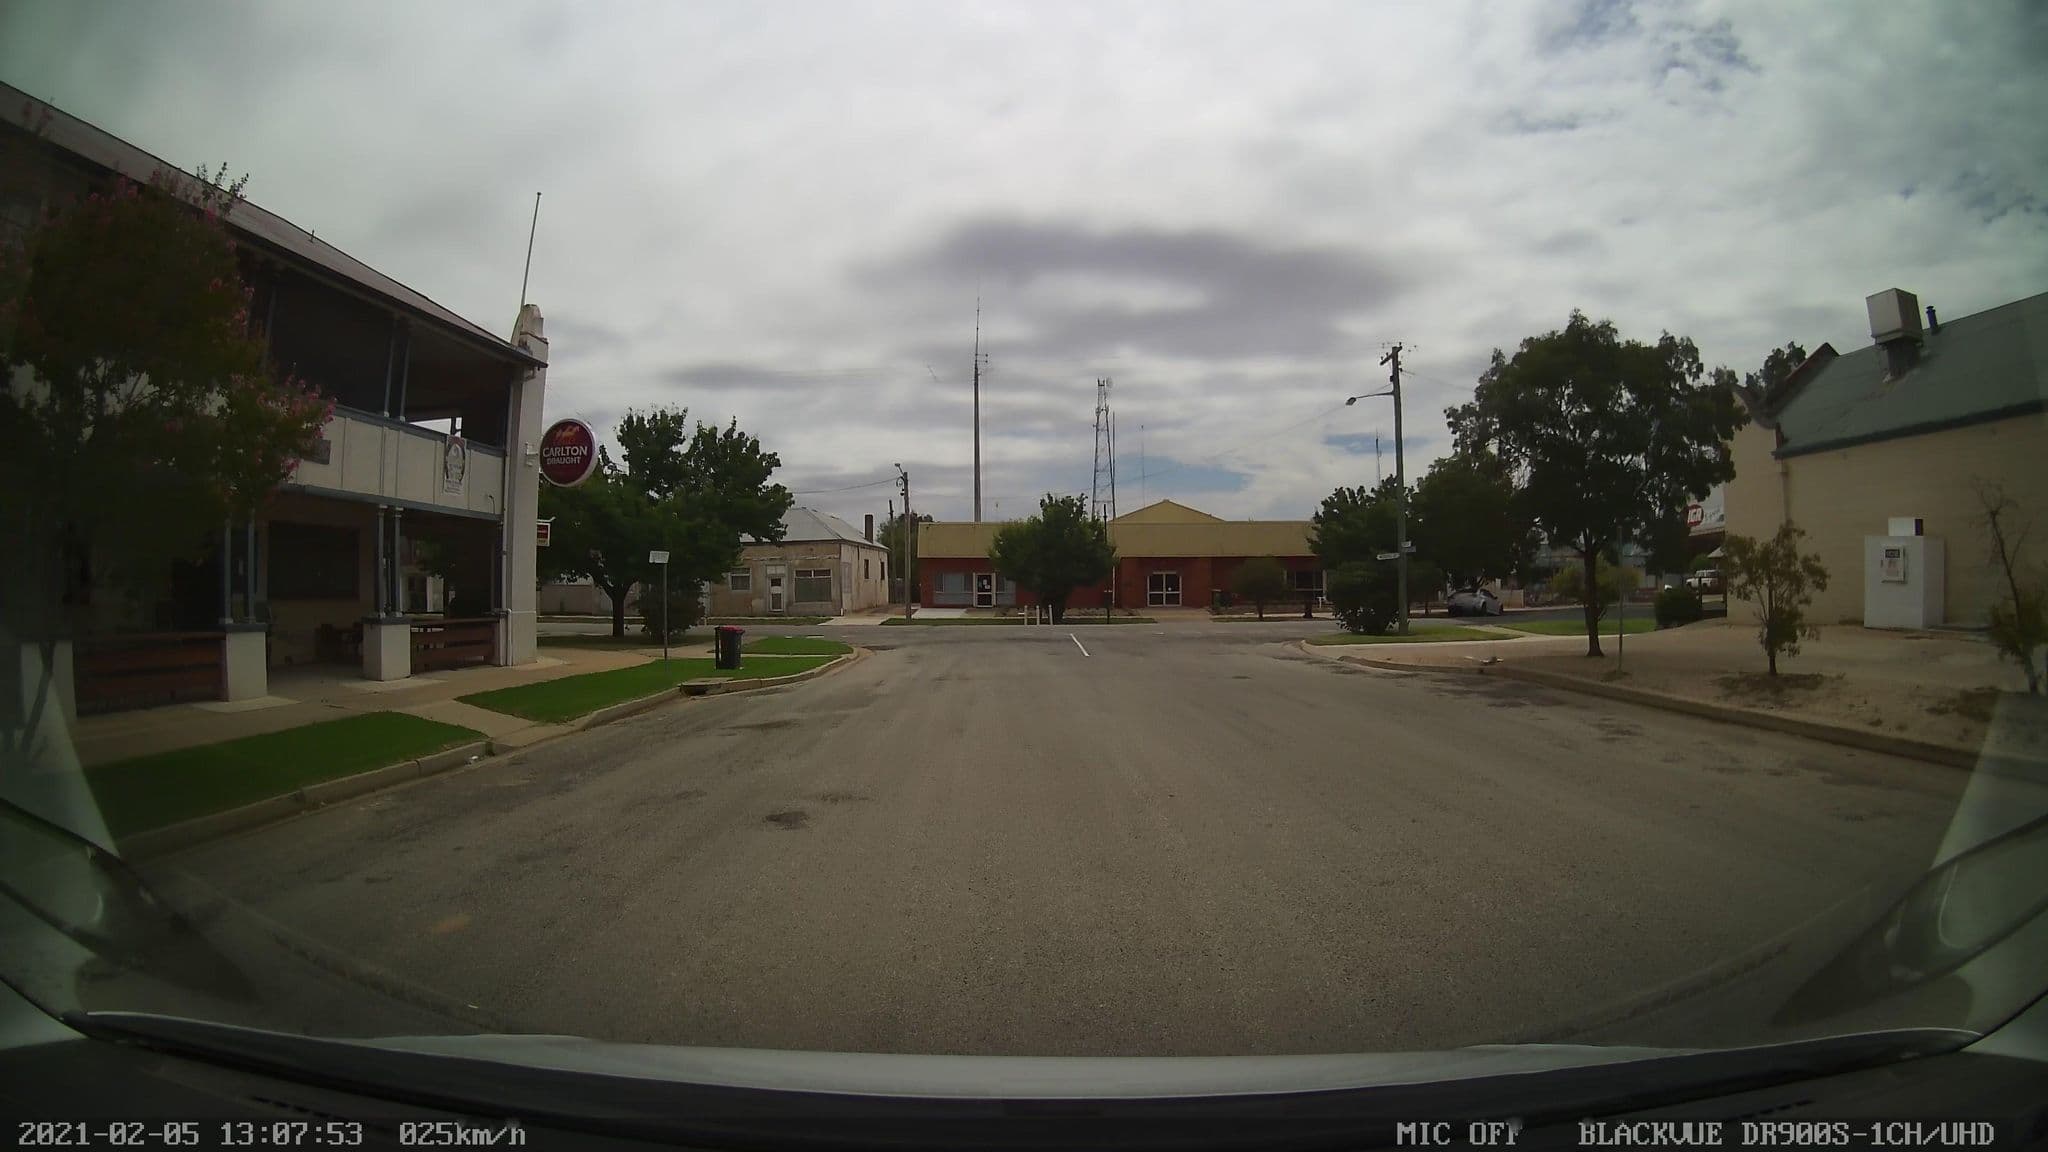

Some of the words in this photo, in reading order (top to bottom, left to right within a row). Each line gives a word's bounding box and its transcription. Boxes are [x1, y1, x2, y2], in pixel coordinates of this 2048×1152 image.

[542, 446, 588, 457] CARLTON
[546, 457, 581, 465] DRAUGHT
[1687, 508, 1702, 524] IGA
